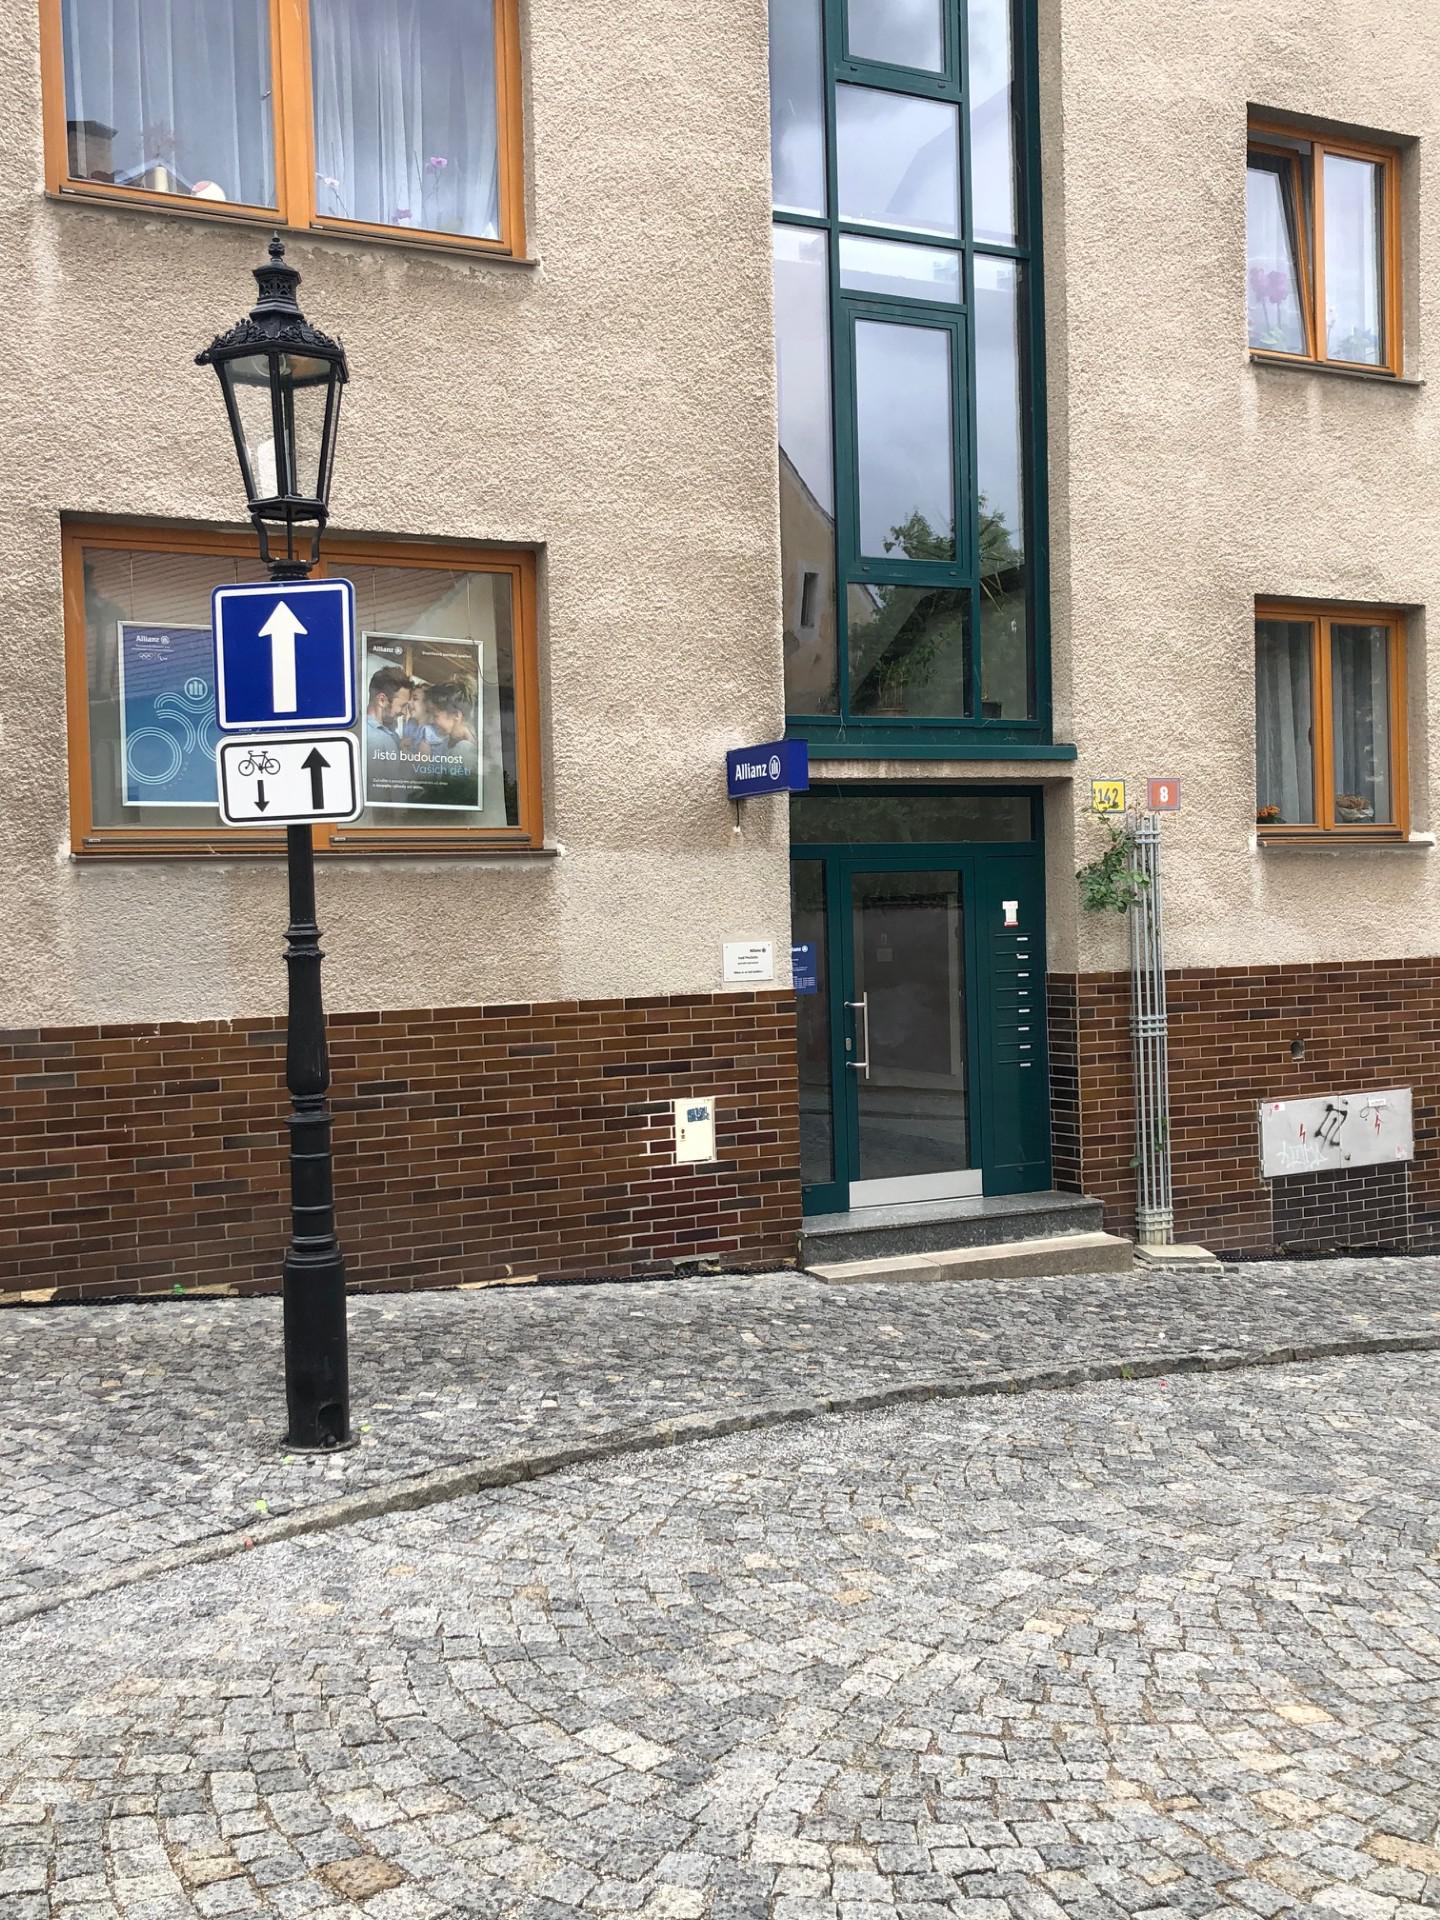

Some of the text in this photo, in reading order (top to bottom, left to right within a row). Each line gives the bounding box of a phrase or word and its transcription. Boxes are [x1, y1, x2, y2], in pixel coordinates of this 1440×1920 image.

[135, 635, 160, 643] Allianz
[372, 645, 394, 653] Allianz
[372, 748, 464, 764] Jistá budoucnost
[735, 762, 768, 782] Allianz
[1097, 787, 1119, 805] 142
[1159, 785, 1169, 803] 8
